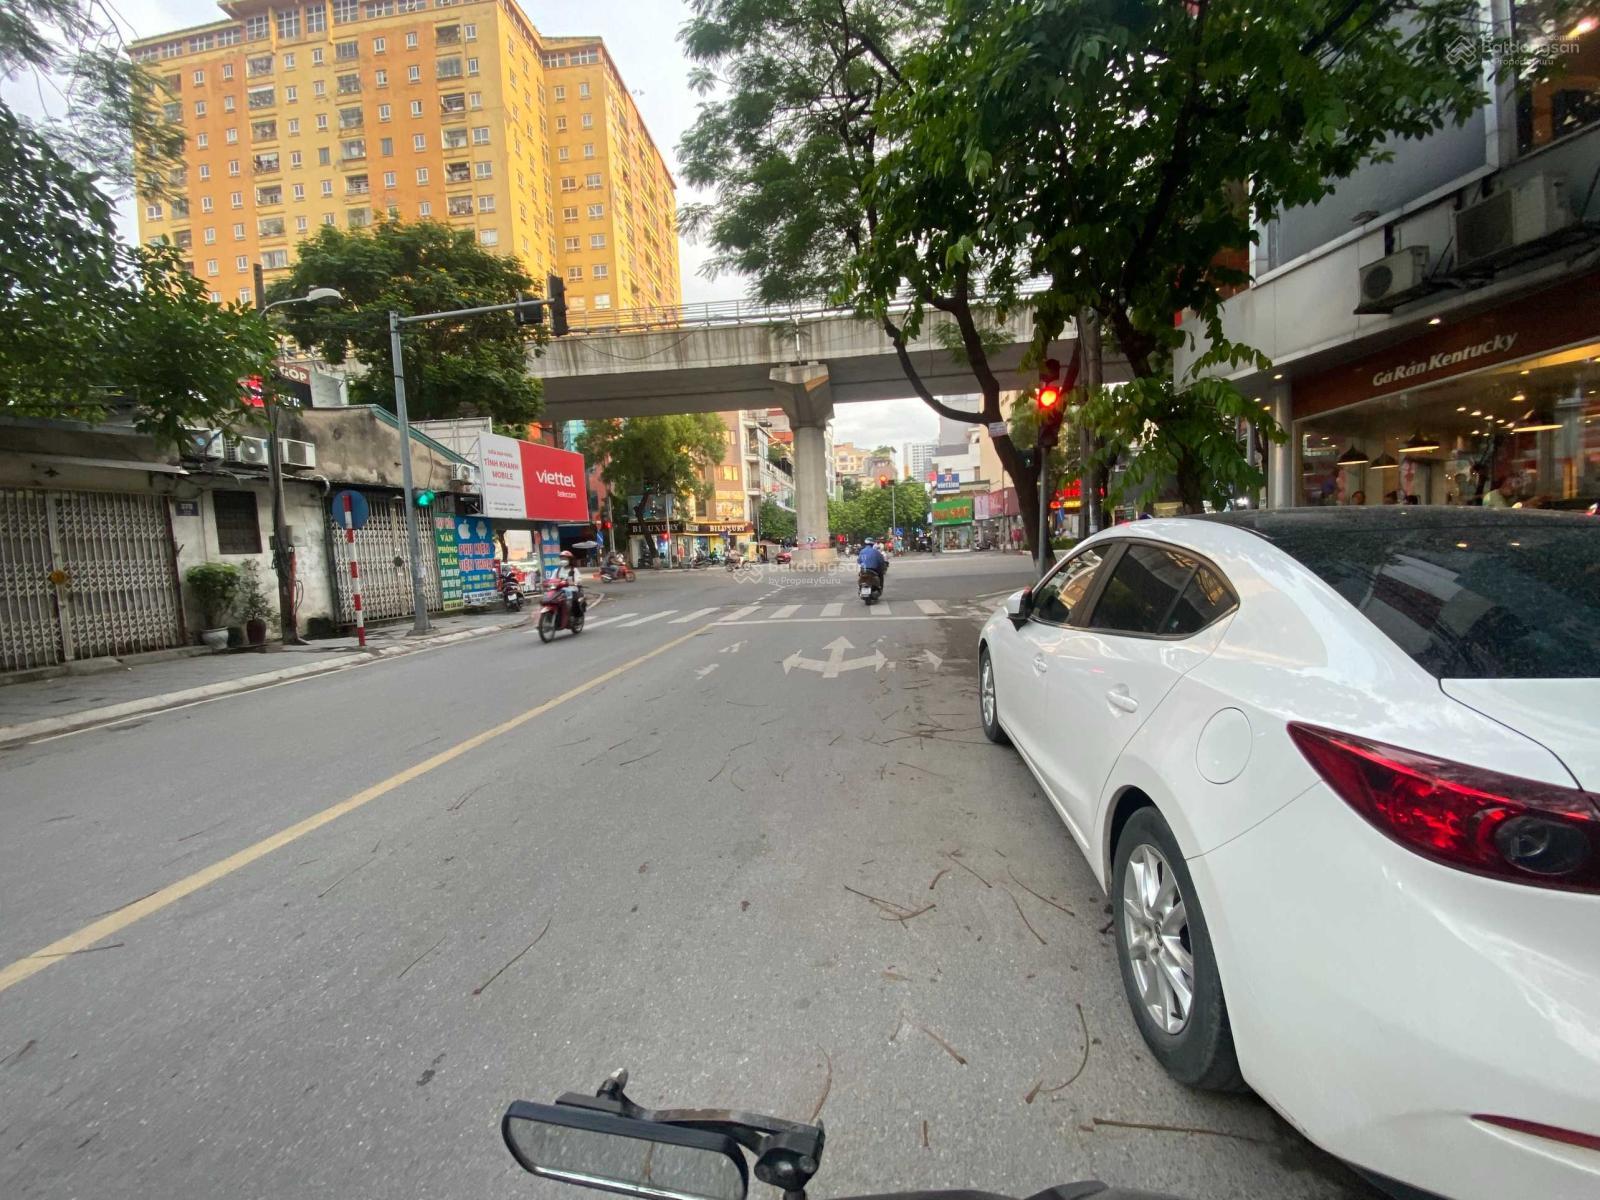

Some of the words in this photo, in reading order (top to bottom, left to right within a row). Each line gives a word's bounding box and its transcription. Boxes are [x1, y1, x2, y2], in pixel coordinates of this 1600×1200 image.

[1372, 370, 1393, 387] Gà
[1393, 360, 1427, 380] Rán
[1427, 332, 1519, 370] Kentucky
[536, 469, 576, 488] viettel
